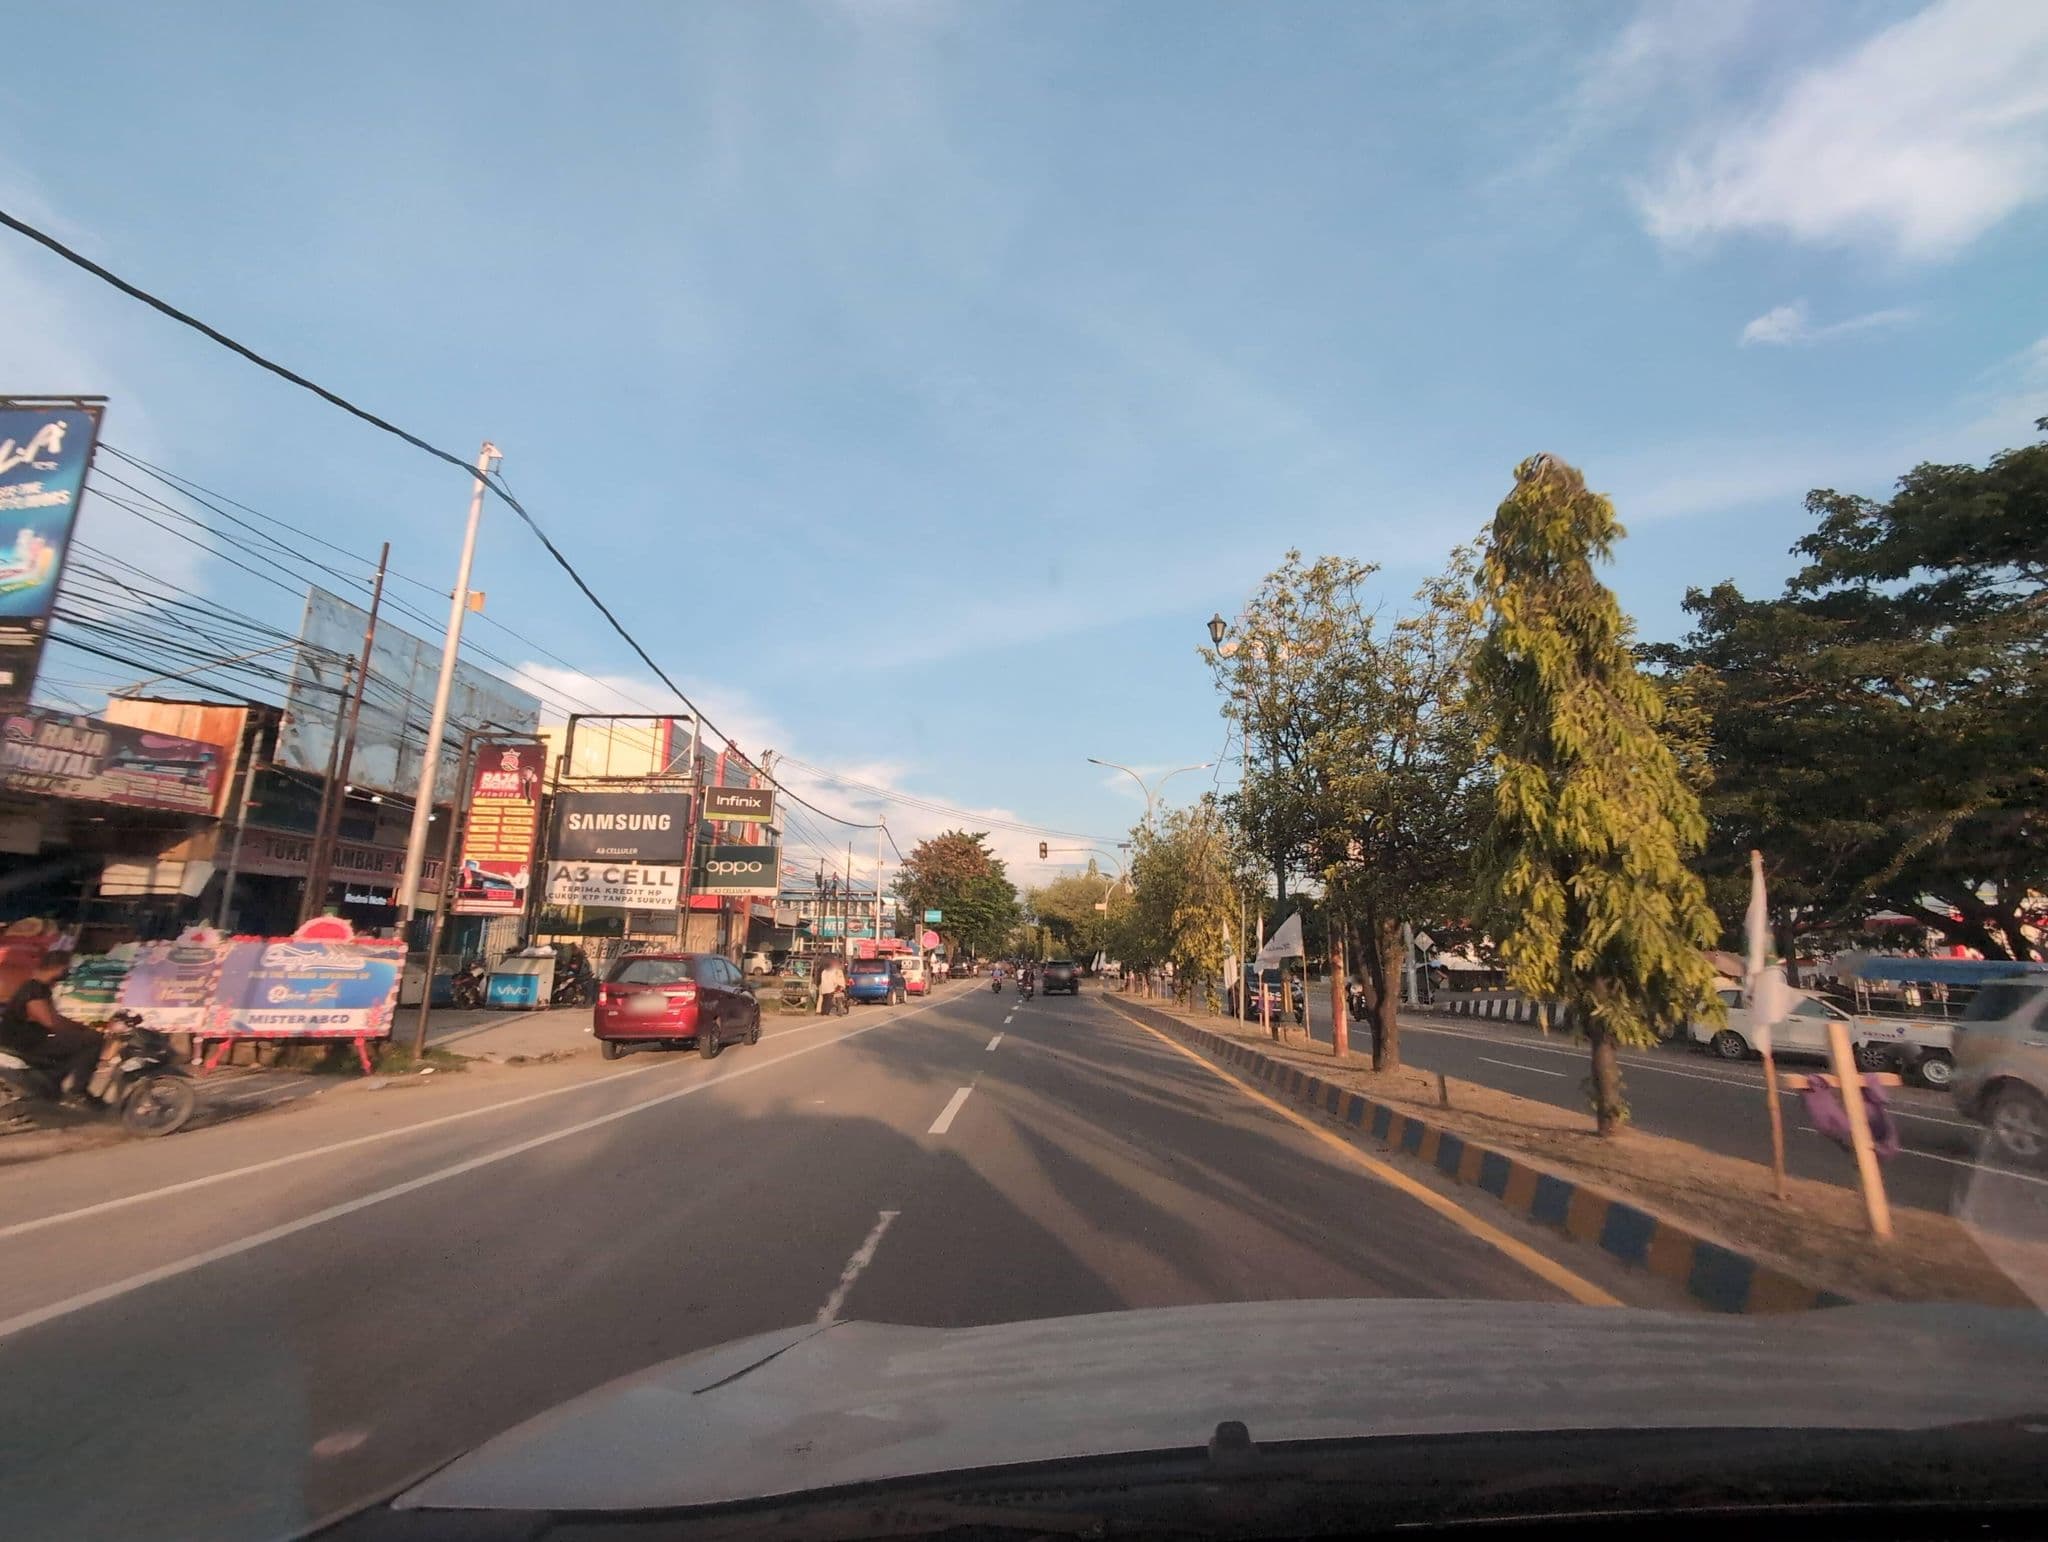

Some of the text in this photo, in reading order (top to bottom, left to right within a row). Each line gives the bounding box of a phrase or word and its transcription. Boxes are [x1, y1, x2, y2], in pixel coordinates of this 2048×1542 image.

[716, 794, 762, 808] Infinix
[568, 813, 671, 831] SAMSUNG
[706, 860, 762, 875] oppo
[552, 866, 674, 887] A3 CELL
[562, 885, 601, 893] TERIMA
[605, 887, 644, 896] KREDIT
[548, 891, 579, 900] CUKUP
[603, 895, 633, 903] TANPA
[637, 897, 673, 905] SURVEY
[497, 984, 530, 995] vivo
[248, 1014, 350, 1025] MISTER ABCD
